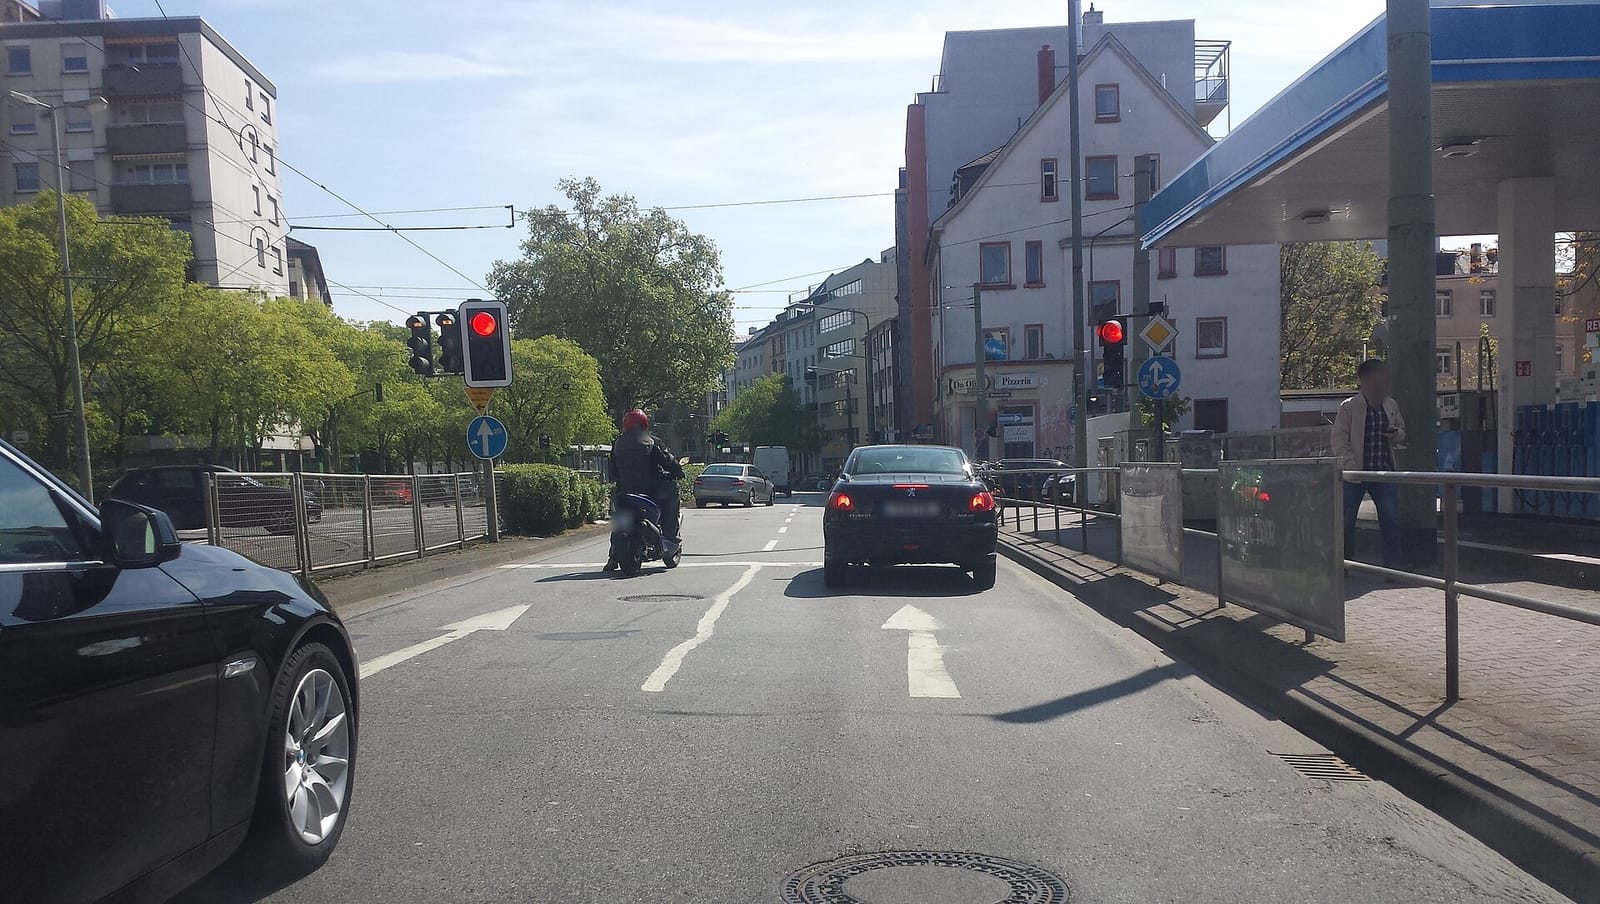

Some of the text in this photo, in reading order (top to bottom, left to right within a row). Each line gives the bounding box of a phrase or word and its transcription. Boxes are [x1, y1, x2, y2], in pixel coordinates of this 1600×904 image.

[1587, 320, 1600, 331] RE
[953, 381, 965, 389] Da
[1002, 376, 1031, 386] Pizzeria
